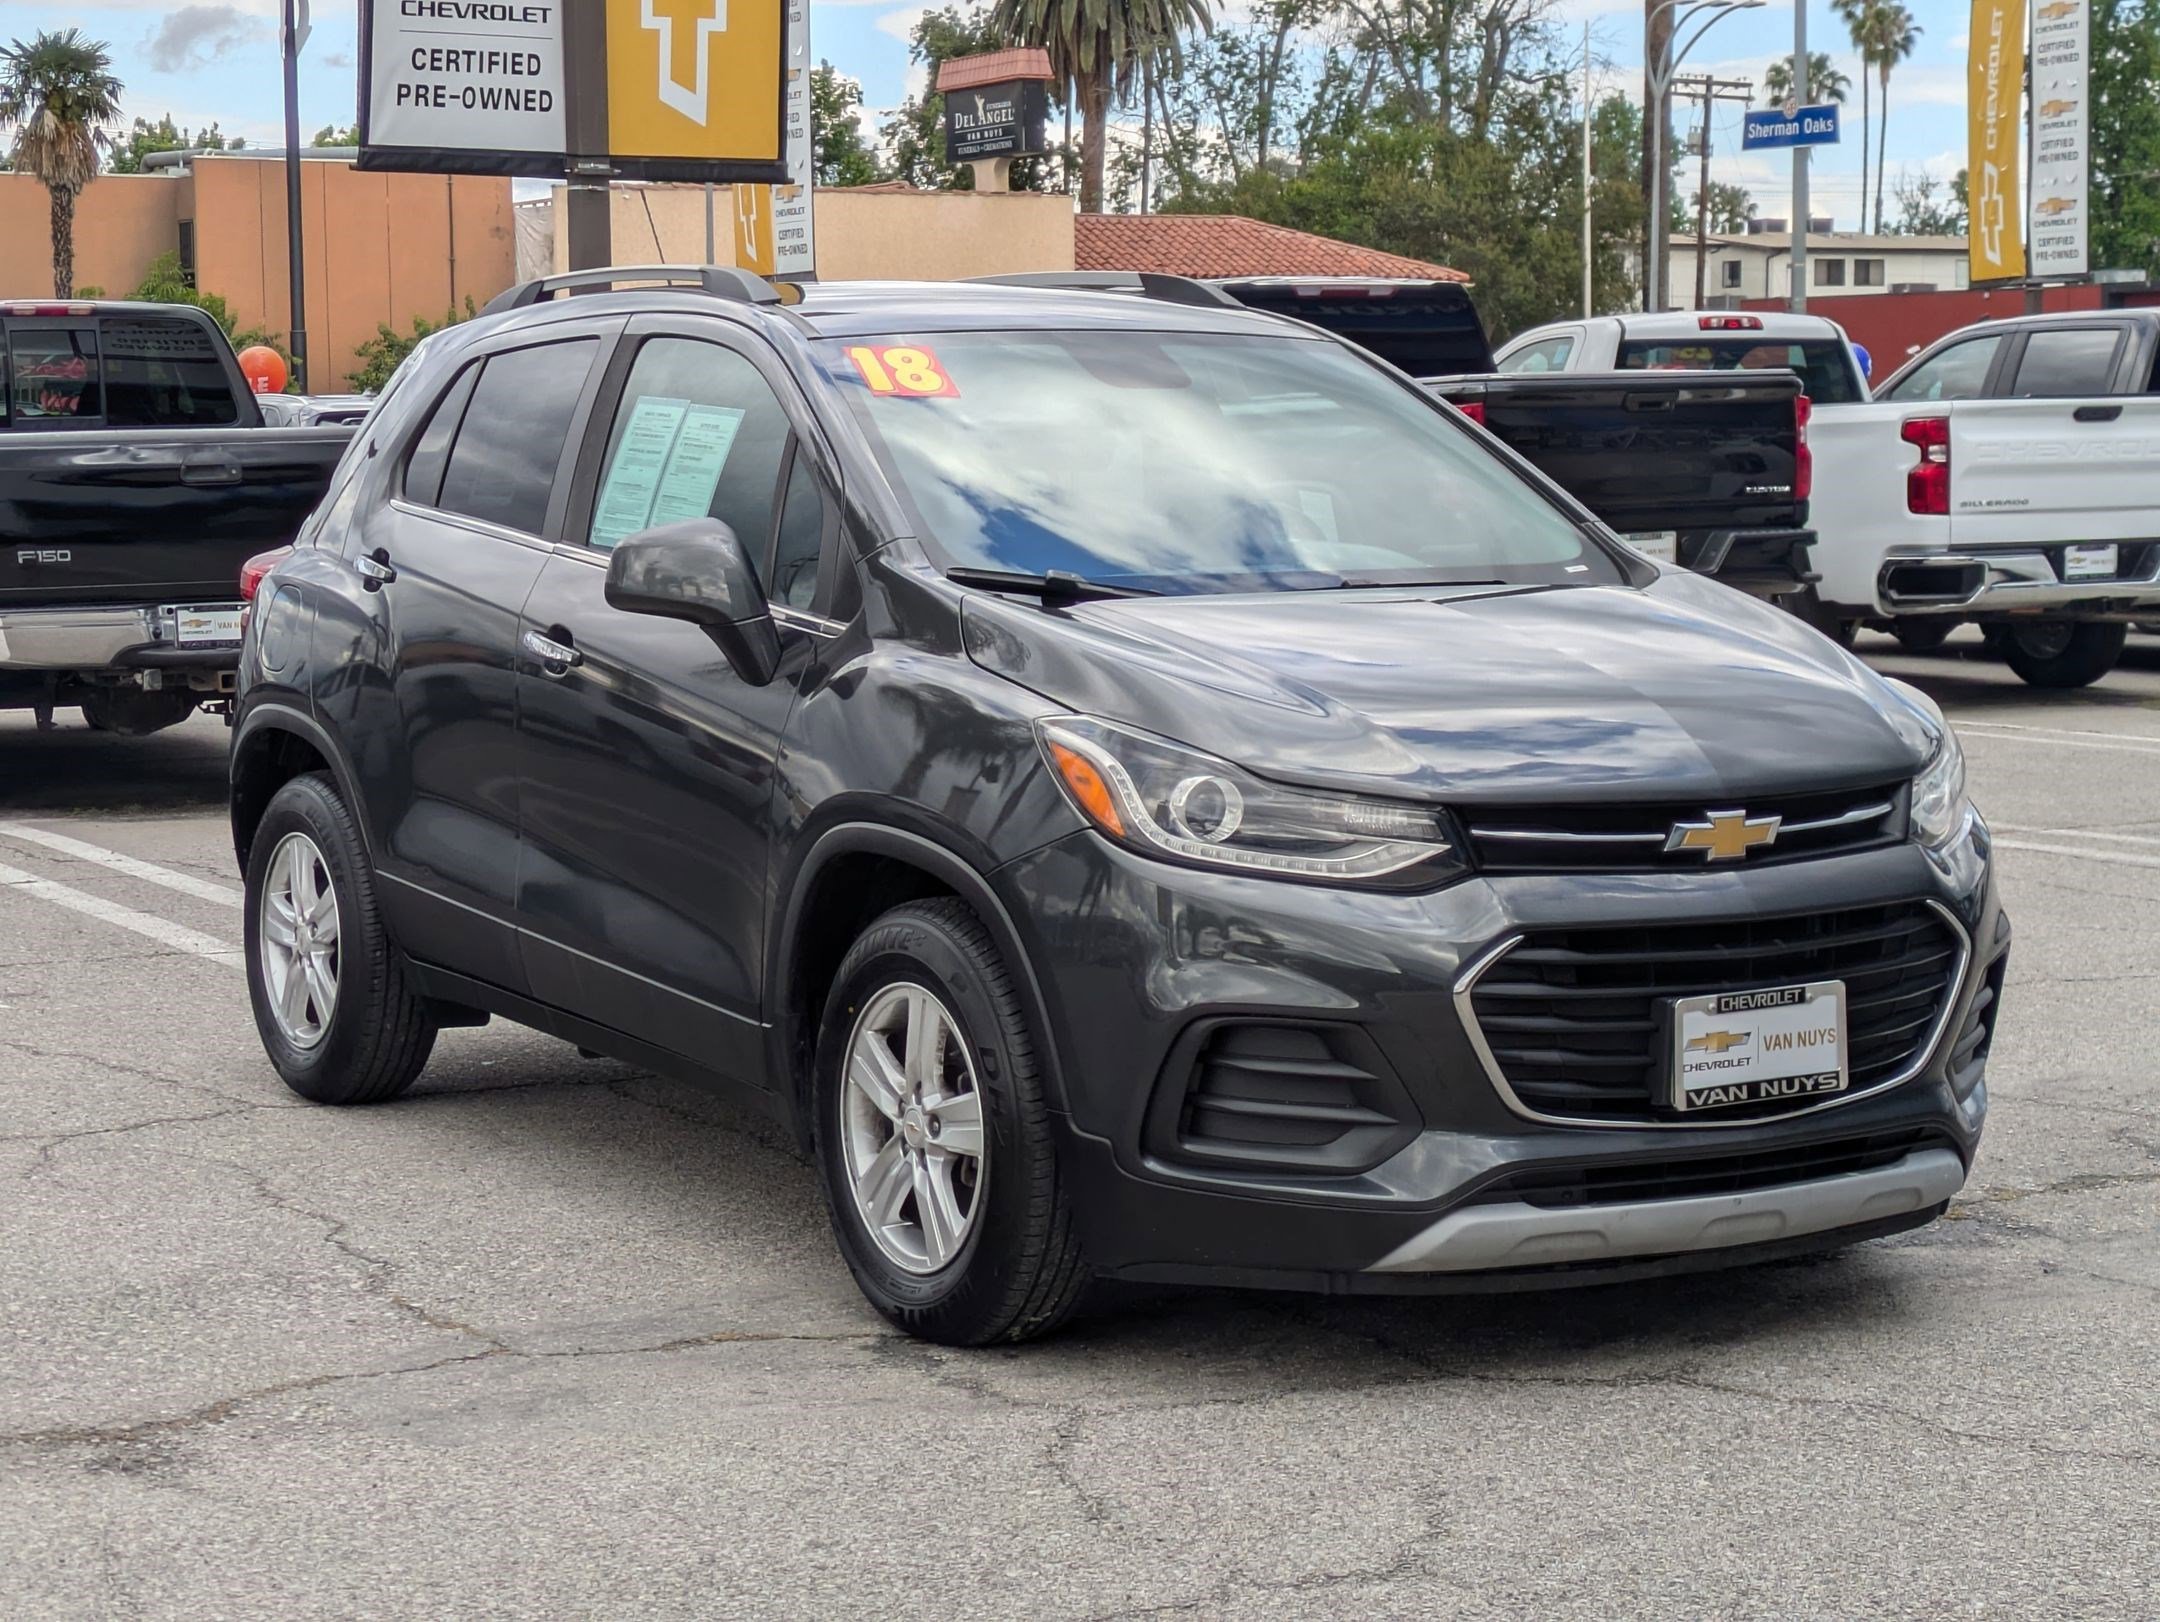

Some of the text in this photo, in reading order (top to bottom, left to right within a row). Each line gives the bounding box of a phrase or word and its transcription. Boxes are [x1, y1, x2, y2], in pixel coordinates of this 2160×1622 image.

[400, 0, 552, 23] CHEVROLET
[411, 48, 541, 76] CERTIFIED
[1986, 8, 2004, 150] CHEVROLET
[396, 83, 553, 112] PRE-OWNED
[1748, 118, 1834, 139] Sherman Oaks
[850, 347, 945, 393] 18
[1960, 499, 2029, 508] SILVERADO
[1721, 990, 1802, 1012] CHEVROLET
[1764, 1028, 1836, 1051] VAN NUYS
[1683, 1057, 1751, 1073] CHEVROLET
[1689, 1073, 1838, 1106] VAN NUYS
